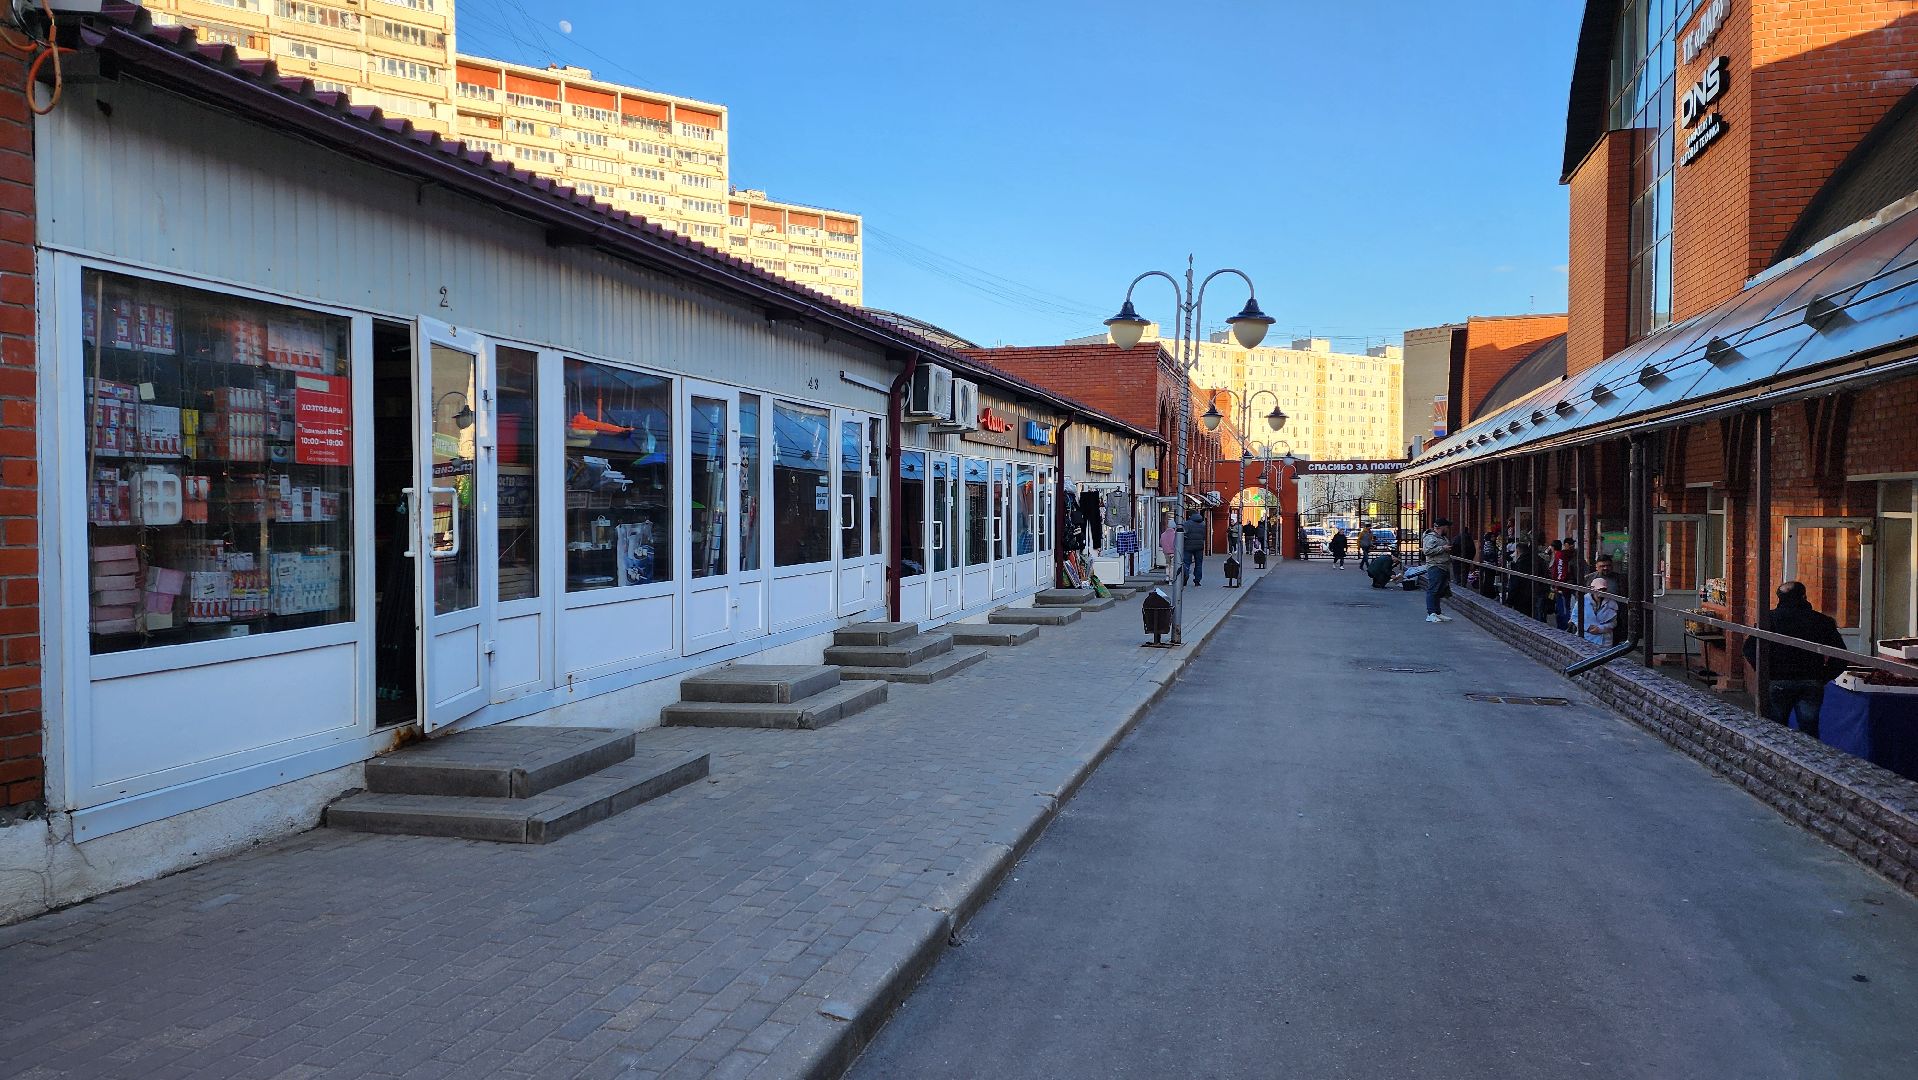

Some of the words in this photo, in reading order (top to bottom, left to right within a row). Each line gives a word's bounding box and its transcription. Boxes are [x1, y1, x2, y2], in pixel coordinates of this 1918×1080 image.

[1682, 56, 1720, 130] DNS
[301, 403, 343, 414] ХОЗТОВАРЫ
[327, 428, 343, 436] №42
[1308, 463, 1354, 471] СПАСИБО
[1355, 463, 1369, 471] ЗА
